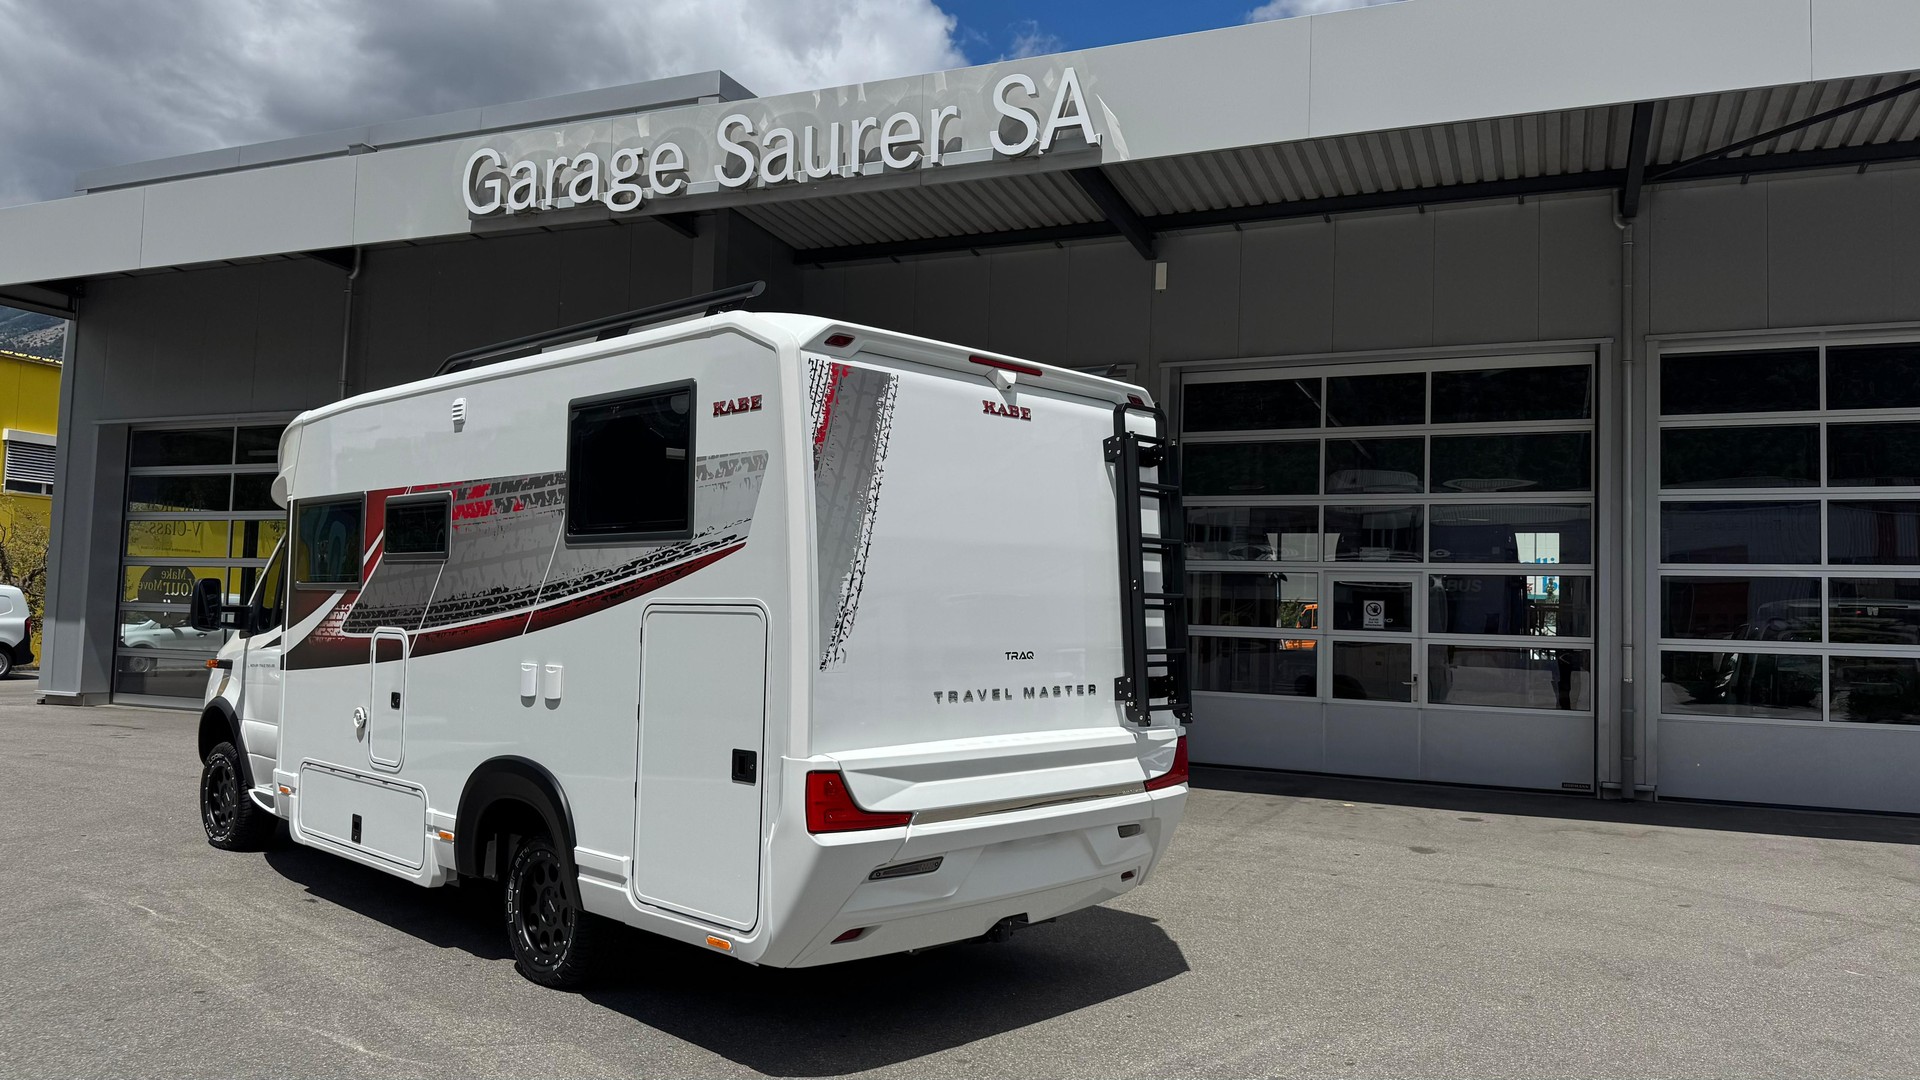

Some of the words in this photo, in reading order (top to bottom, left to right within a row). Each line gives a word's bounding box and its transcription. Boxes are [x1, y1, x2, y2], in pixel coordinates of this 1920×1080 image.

[462, 142, 687, 215] Garage
[714, 105, 959, 188] Saurer
[989, 67, 1100, 156] SA
[712, 394, 763, 418] KABE
[982, 400, 1032, 421] KABE
[1005, 651, 1035, 661] TRAQ
[933, 688, 1013, 704] TRAVEL
[1023, 684, 1097, 700] MASTER
